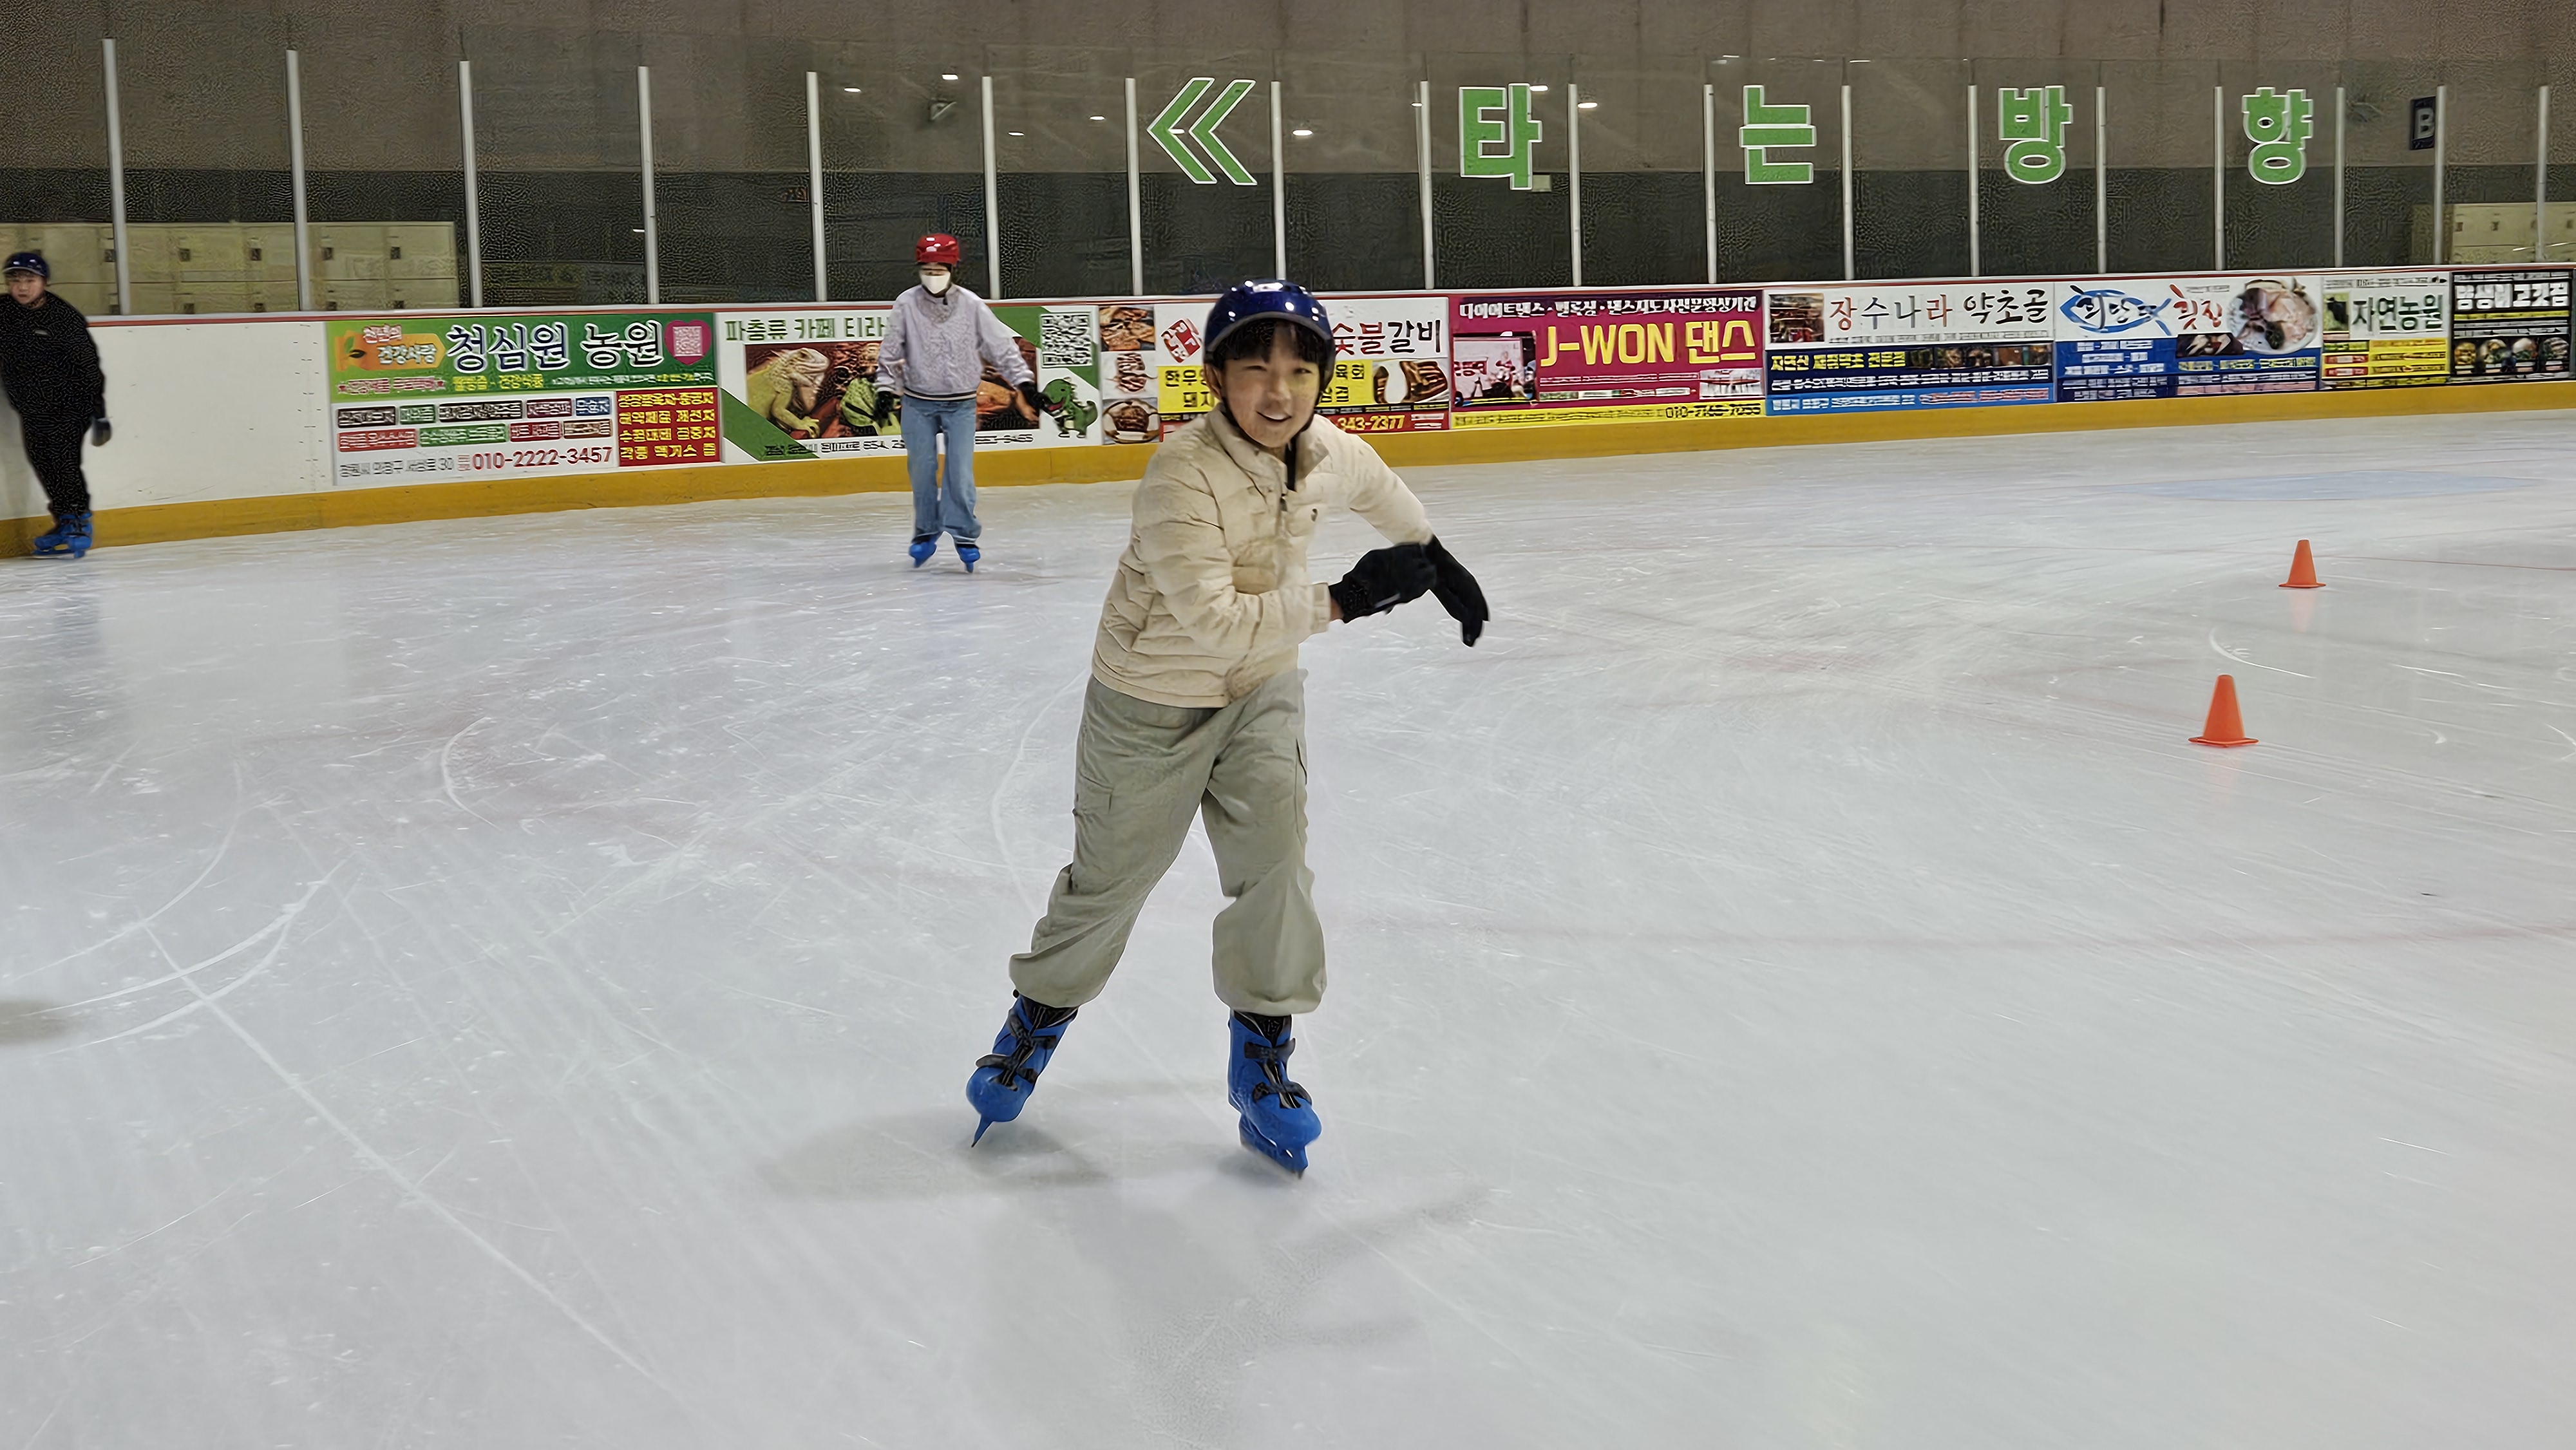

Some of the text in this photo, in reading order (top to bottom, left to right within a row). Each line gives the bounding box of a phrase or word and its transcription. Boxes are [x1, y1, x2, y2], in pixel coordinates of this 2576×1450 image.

[2415, 107, 2435, 138] B
[724, 316, 891, 341] 파충류 카페 티라
[1829, 293, 1953, 331] 장수나라
[1963, 288, 2049, 325] 약초골
[2352, 294, 2443, 332] 자연농원
[446, 320, 665, 374] 청심원 농원
[1540, 319, 1757, 366] J-WON 댄스
[471, 446, 612, 472] 010-2222-3457
